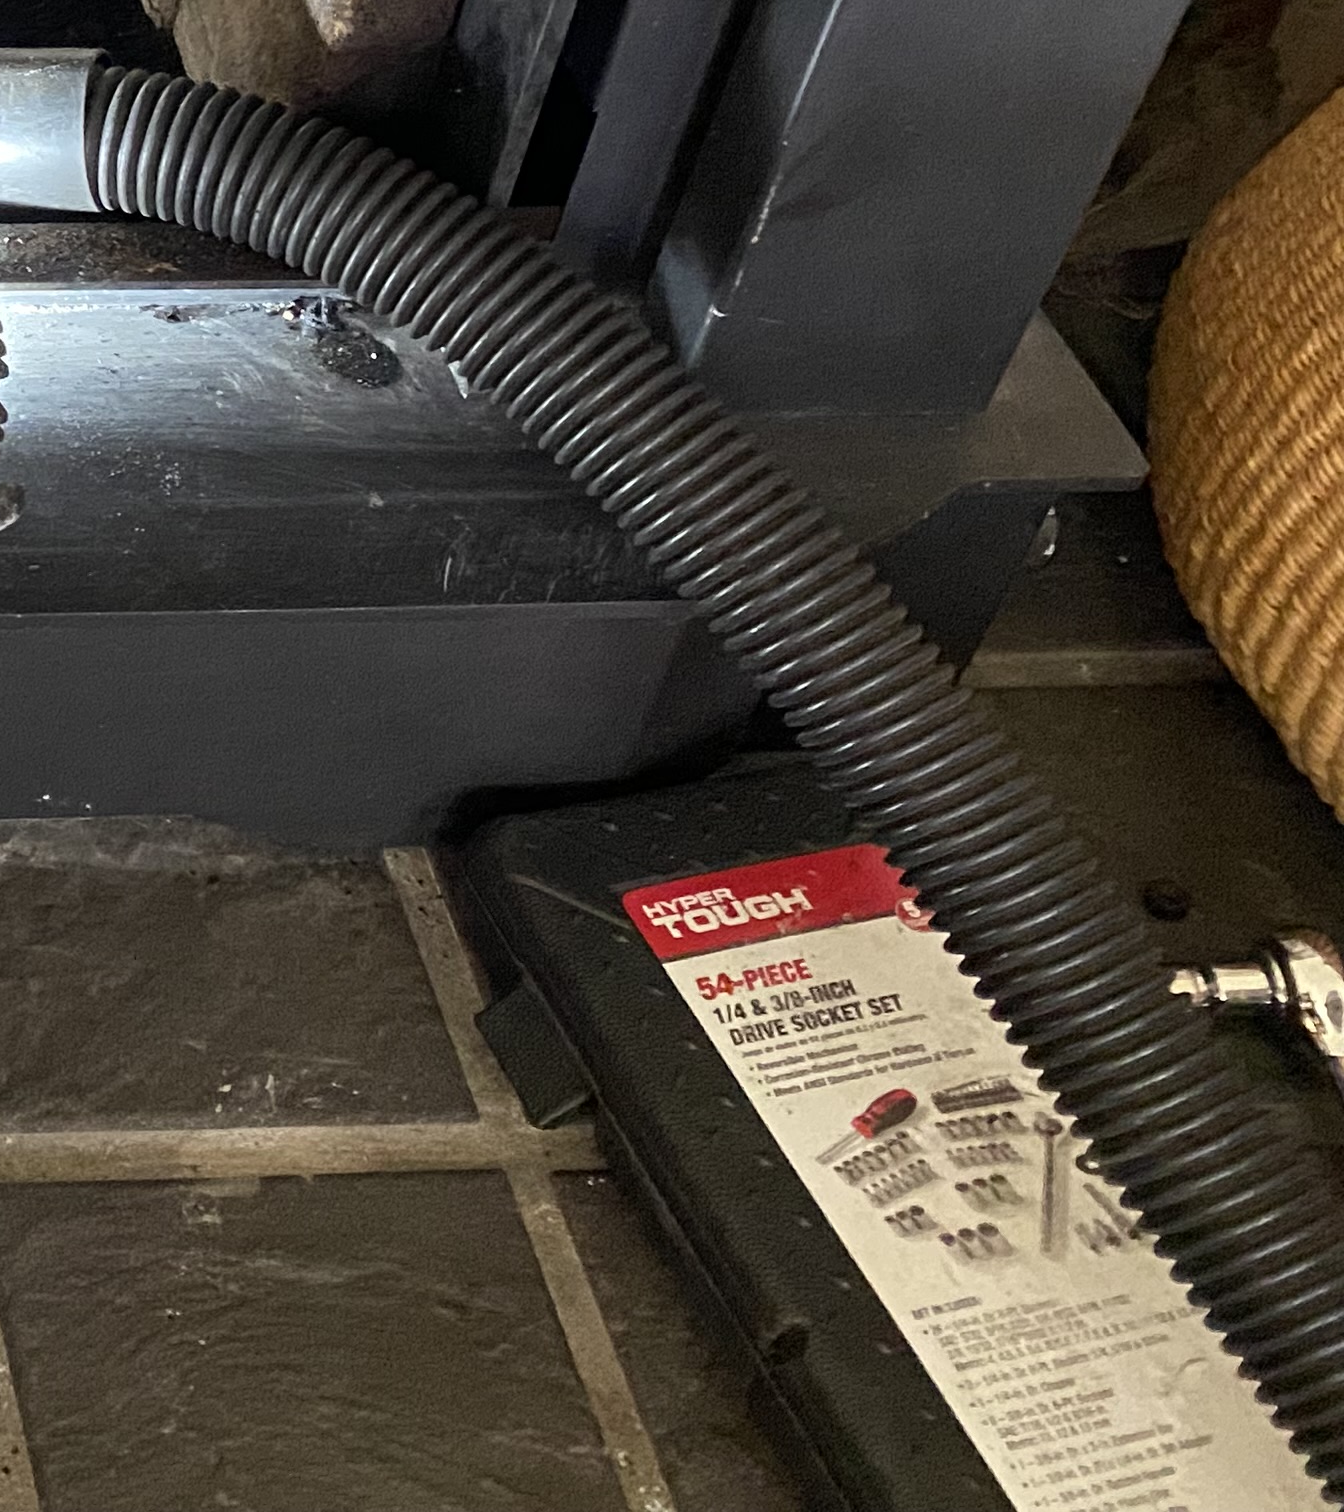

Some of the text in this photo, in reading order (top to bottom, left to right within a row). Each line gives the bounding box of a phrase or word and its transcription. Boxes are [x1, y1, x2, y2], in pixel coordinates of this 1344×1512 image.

[641, 887, 737, 919] HYPER
[650, 887, 814, 939] TOUGH
[695, 958, 813, 1001] 54-PIECE
[712, 979, 857, 1025] 1/4 & 3/8-INCH
[729, 1018, 789, 1047] DRIVE
[790, 1000, 865, 1033] SOCKET
[866, 992, 905, 1017] SET
